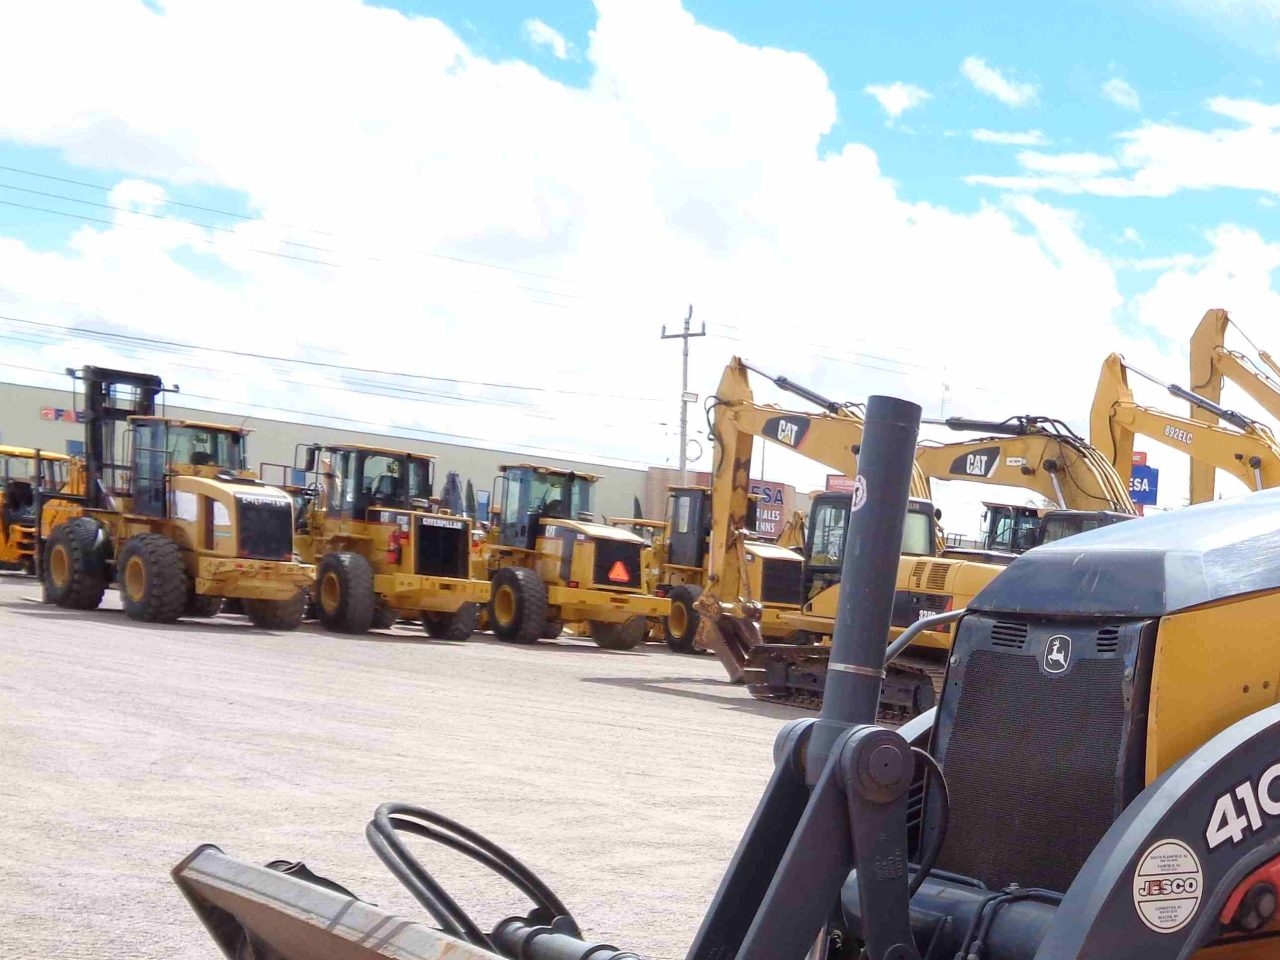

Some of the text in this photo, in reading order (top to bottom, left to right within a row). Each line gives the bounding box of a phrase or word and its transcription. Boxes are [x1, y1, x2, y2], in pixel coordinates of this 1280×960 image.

[777, 419, 798, 446] CAT
[1164, 425, 1193, 444] 892ELC
[966, 454, 988, 475] CAT
[1138, 878, 1198, 897] JESCO
